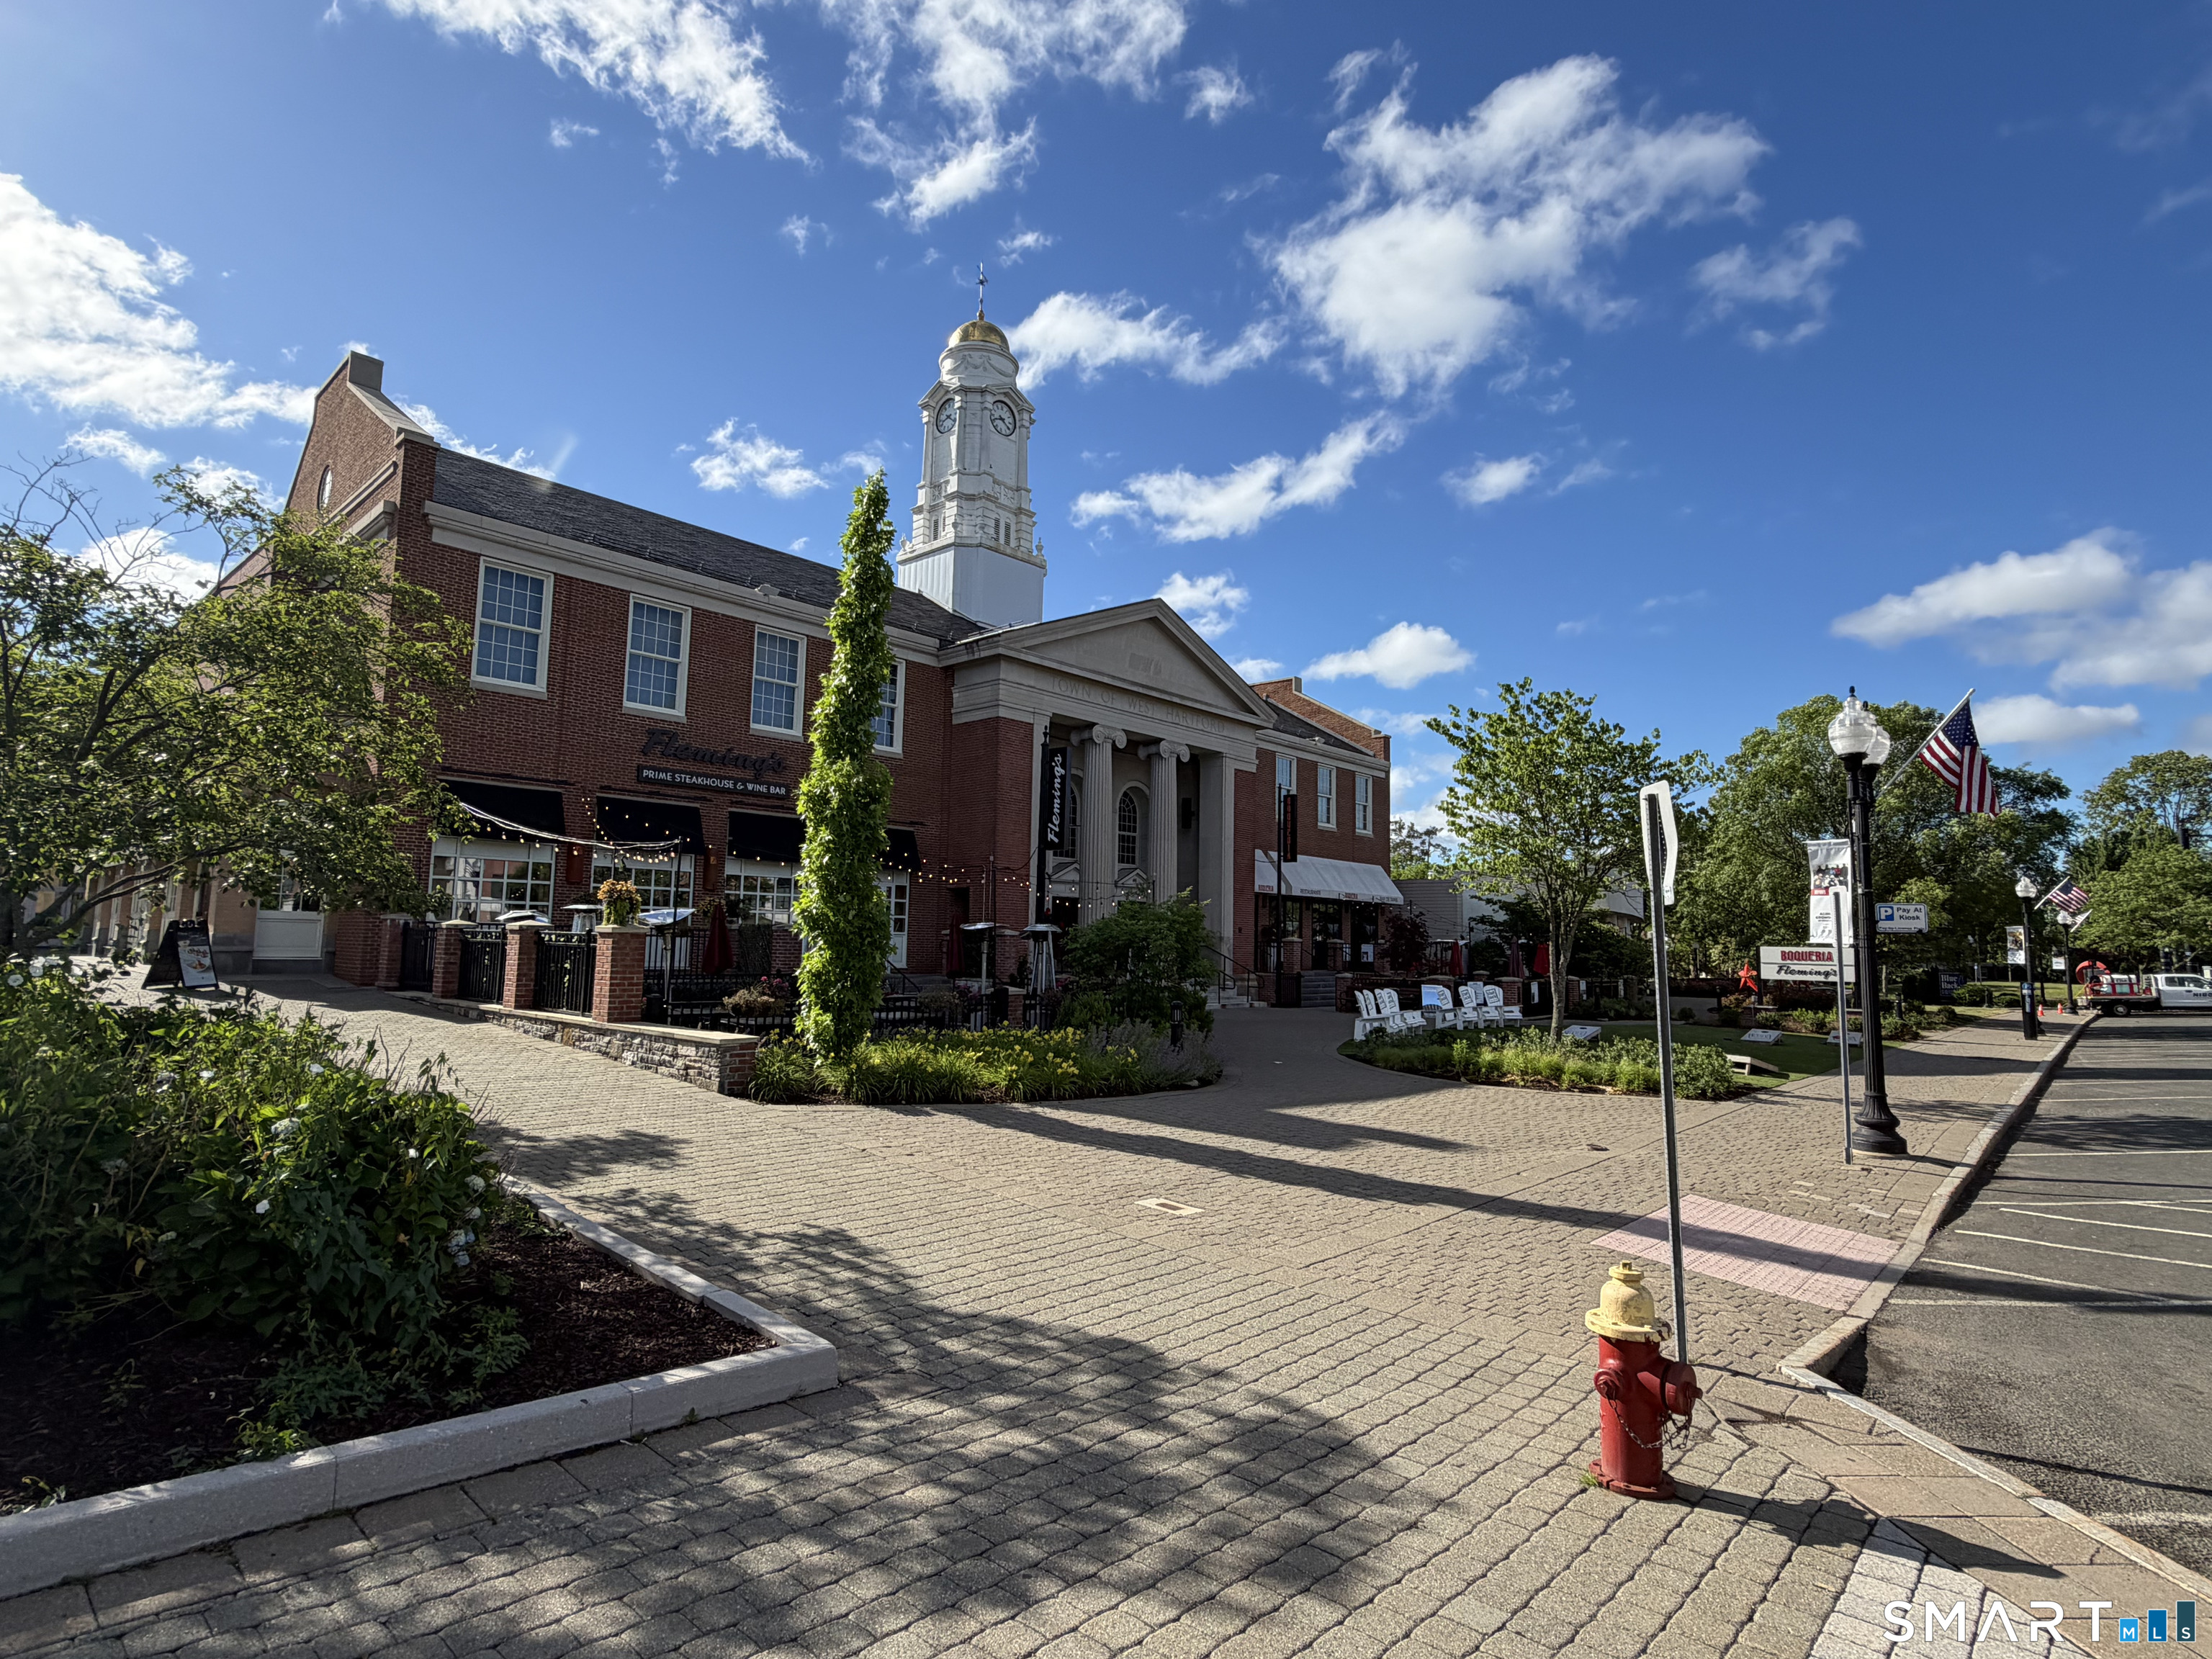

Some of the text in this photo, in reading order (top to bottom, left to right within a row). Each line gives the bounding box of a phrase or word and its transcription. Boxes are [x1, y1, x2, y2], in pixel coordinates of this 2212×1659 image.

[1051, 675, 1225, 733] TOWN OF WEST HARTFORD
[642, 728, 786, 780] Fleming's
[642, 769, 673, 781] PRIME
[675, 773, 734, 789] STEAKHOUSE
[747, 783, 768, 793] WINE
[770, 786, 786, 795] BAR
[1048, 754, 1065, 843] Fleming's
[1776, 965, 1838, 979] Fleming's
[1781, 950, 1834, 962] BOQUERIA
